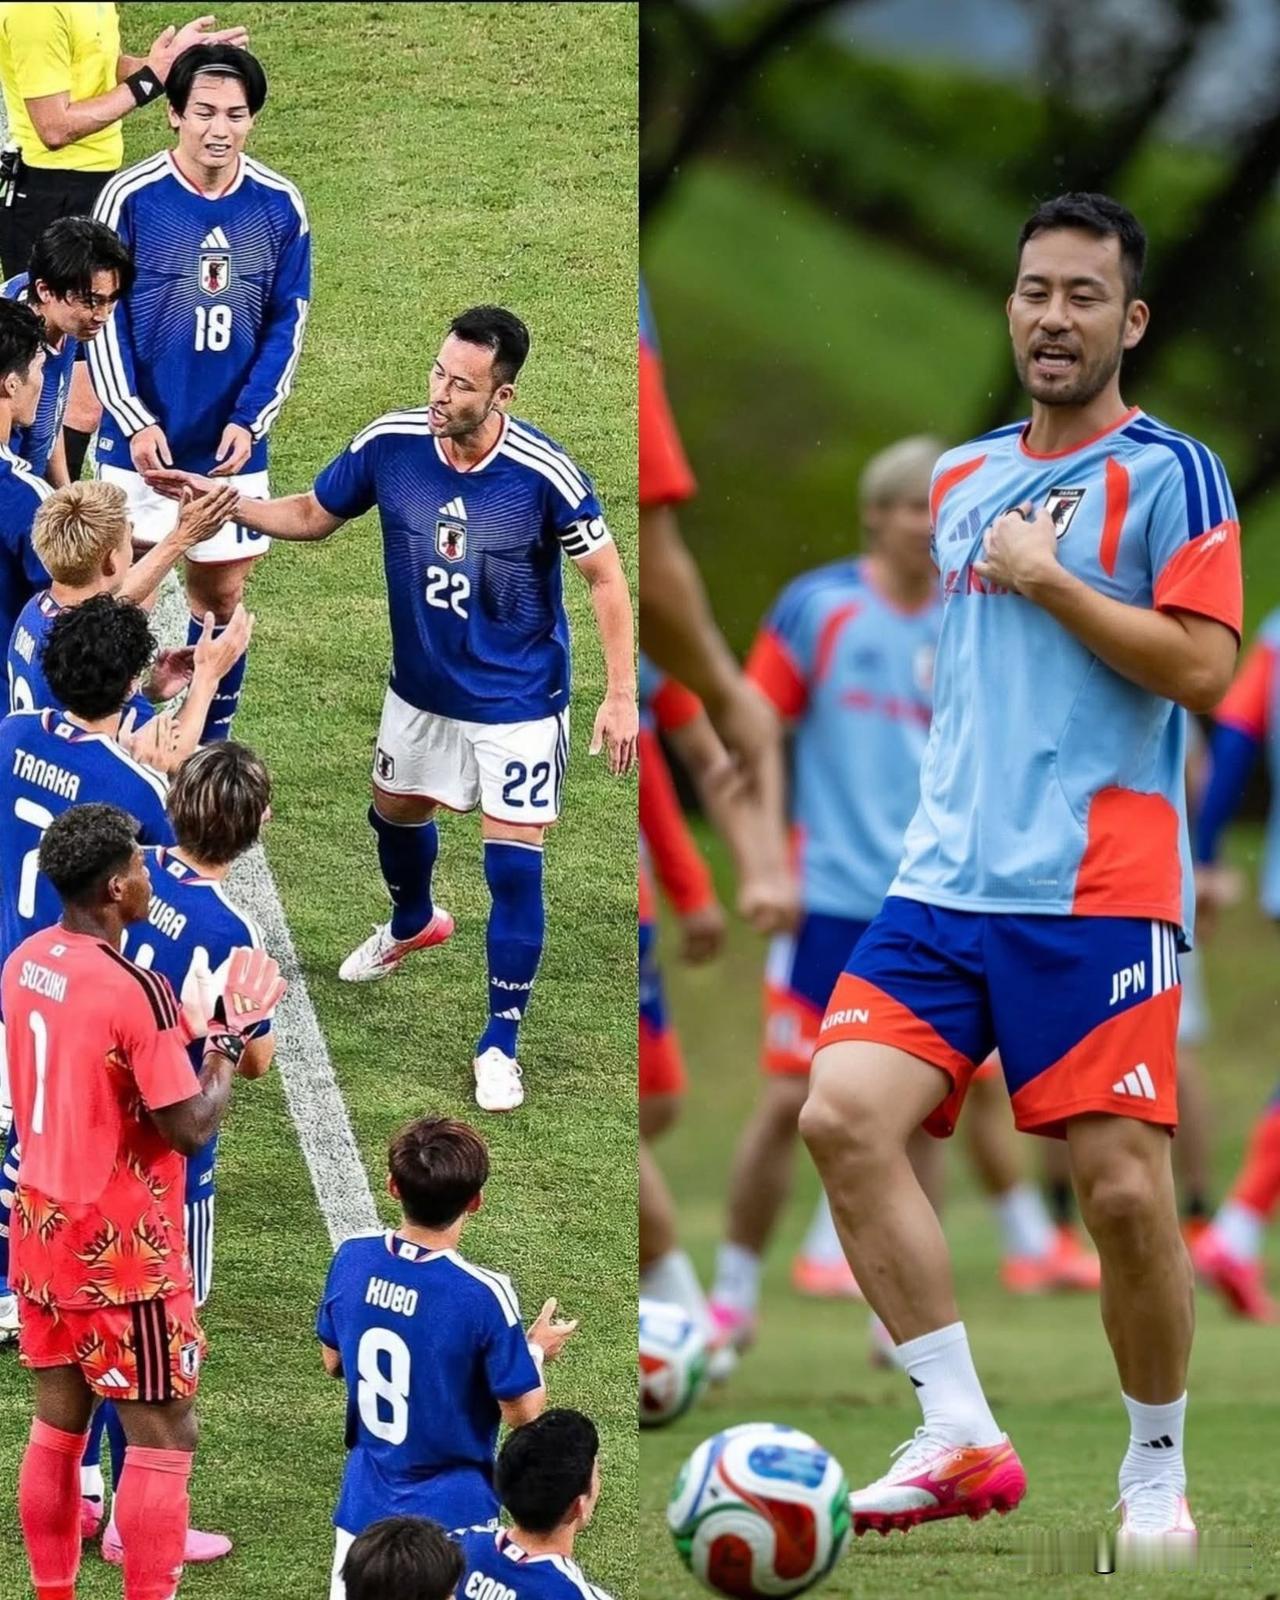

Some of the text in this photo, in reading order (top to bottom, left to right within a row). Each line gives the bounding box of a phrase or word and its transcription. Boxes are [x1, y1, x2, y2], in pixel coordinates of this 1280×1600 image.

[194, 304, 232, 352] 18
[586, 516, 604, 540] C
[426, 565, 470, 619] 22
[13, 748, 81, 801] TANAKA
[502, 761, 550, 807] 22
[14, 797, 55, 919] 7
[19, 961, 67, 1003] SUZUKI
[1109, 960, 1145, 1006] JPN
[29, 1010, 47, 1135] 1
[365, 1277, 418, 1317] KUBO
[357, 1327, 411, 1446] 8
